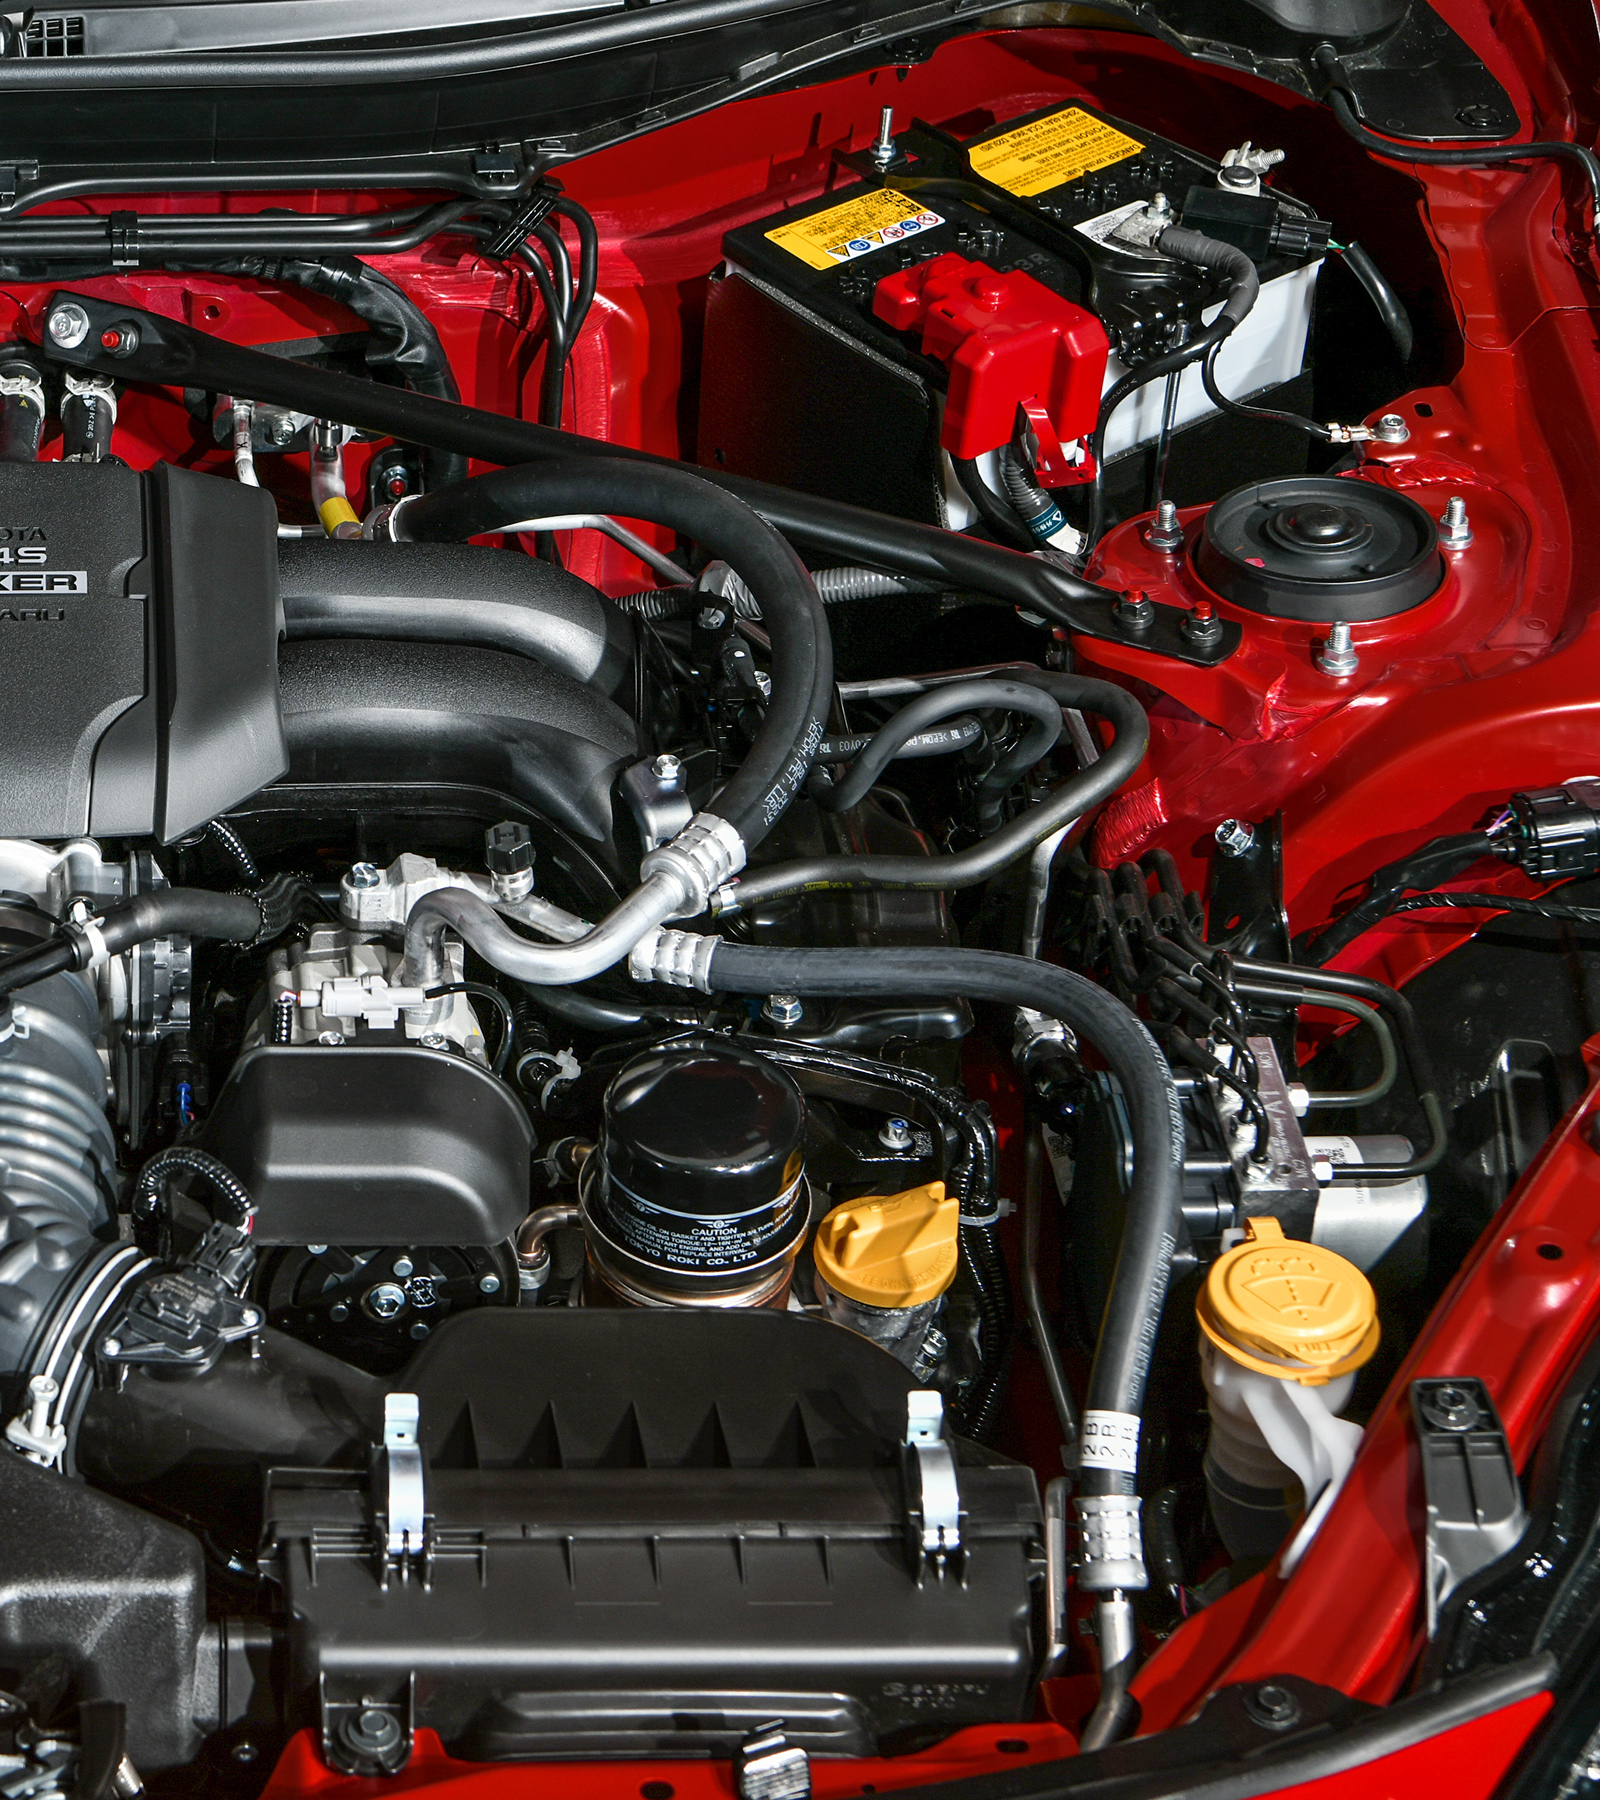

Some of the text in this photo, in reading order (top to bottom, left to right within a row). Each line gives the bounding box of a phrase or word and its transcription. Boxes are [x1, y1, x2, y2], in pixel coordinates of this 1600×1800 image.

[1072, 124, 1107, 140] POISON
[1105, 143, 1141, 160] DANGER
[671, 1231, 699, 1241] GASKET
[717, 1232, 746, 1241] TIGHTEN
[691, 1227, 738, 1237] CAUTION
[656, 1238, 678, 1248] START
[625, 1235, 661, 1257] TOKYO
[667, 1254, 700, 1266] ROKI
